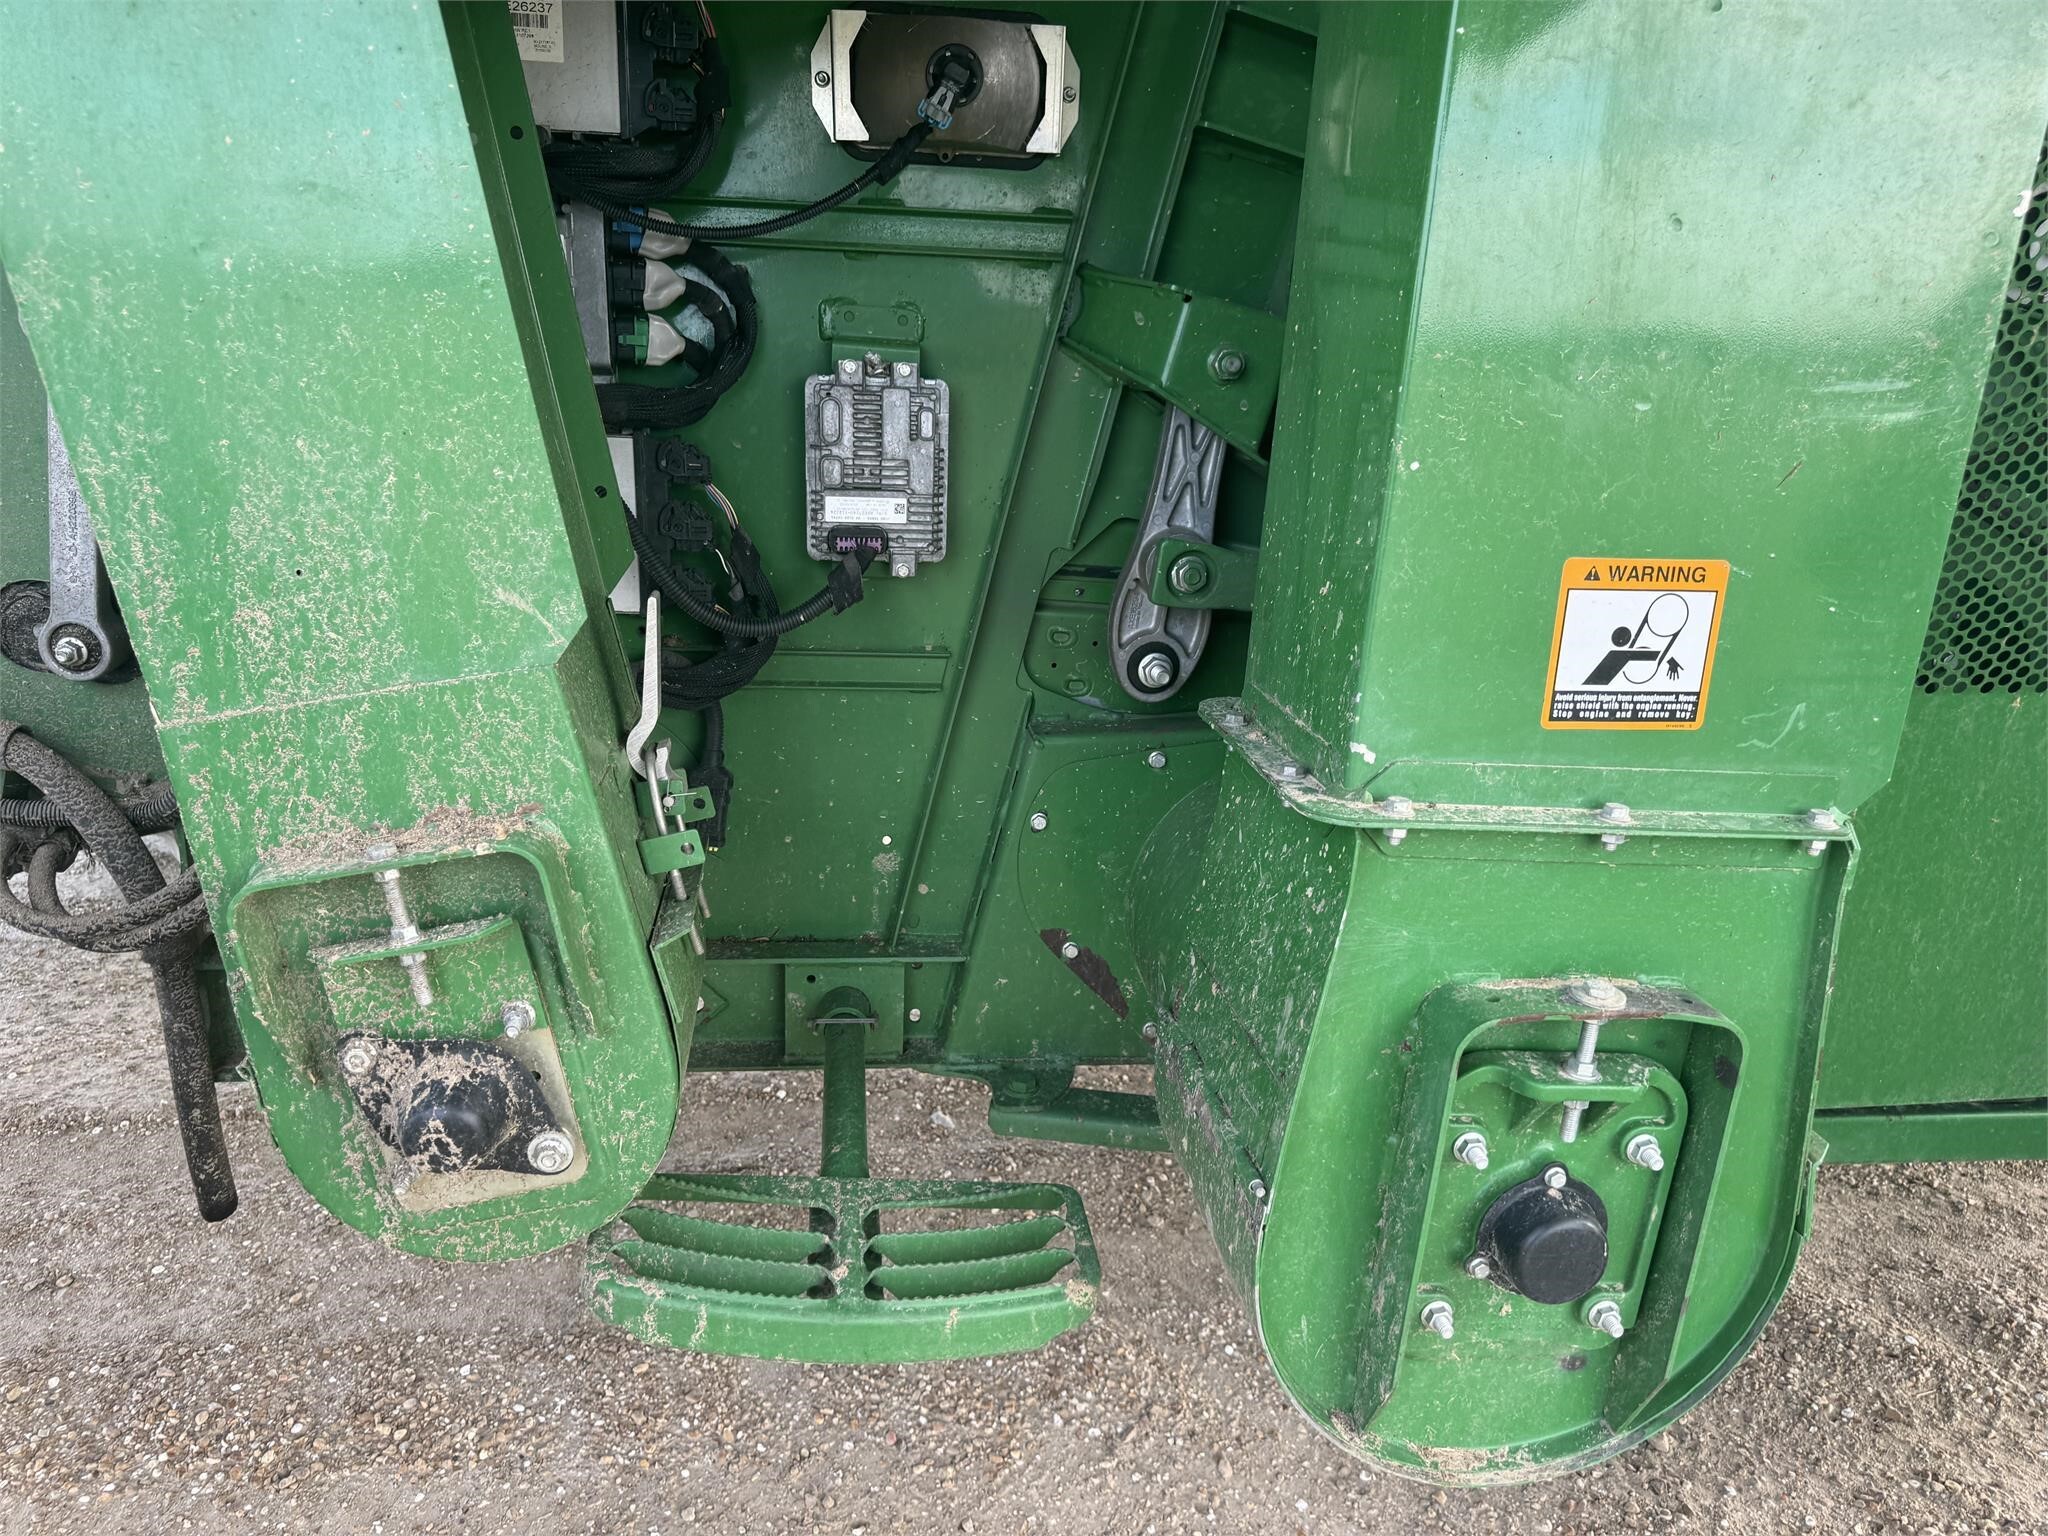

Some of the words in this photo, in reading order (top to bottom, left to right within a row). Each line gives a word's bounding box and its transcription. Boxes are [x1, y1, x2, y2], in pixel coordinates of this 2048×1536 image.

[1608, 565, 1706, 583] WARNING
[1555, 693, 1573, 701] Avoid
[1574, 693, 1597, 701] serious
[1598, 693, 1617, 703] injury
[1617, 693, 1632, 701] from
[1633, 694, 1677, 704] entanglement.
[1554, 702, 1574, 710] raise
[1576, 701, 1601, 710] shield
[1603, 701, 1620, 710] with
[1621, 702, 1634, 710] the
[1635, 702, 1662, 711] engine
[1663, 702, 1695, 711] running.
[1552, 709, 1573, 719] Stop
[1579, 710, 1609, 719] engine
[1615, 710, 1632, 719] and
[1637, 711, 1669, 719] remove
[1675, 710, 1693, 720] key.
